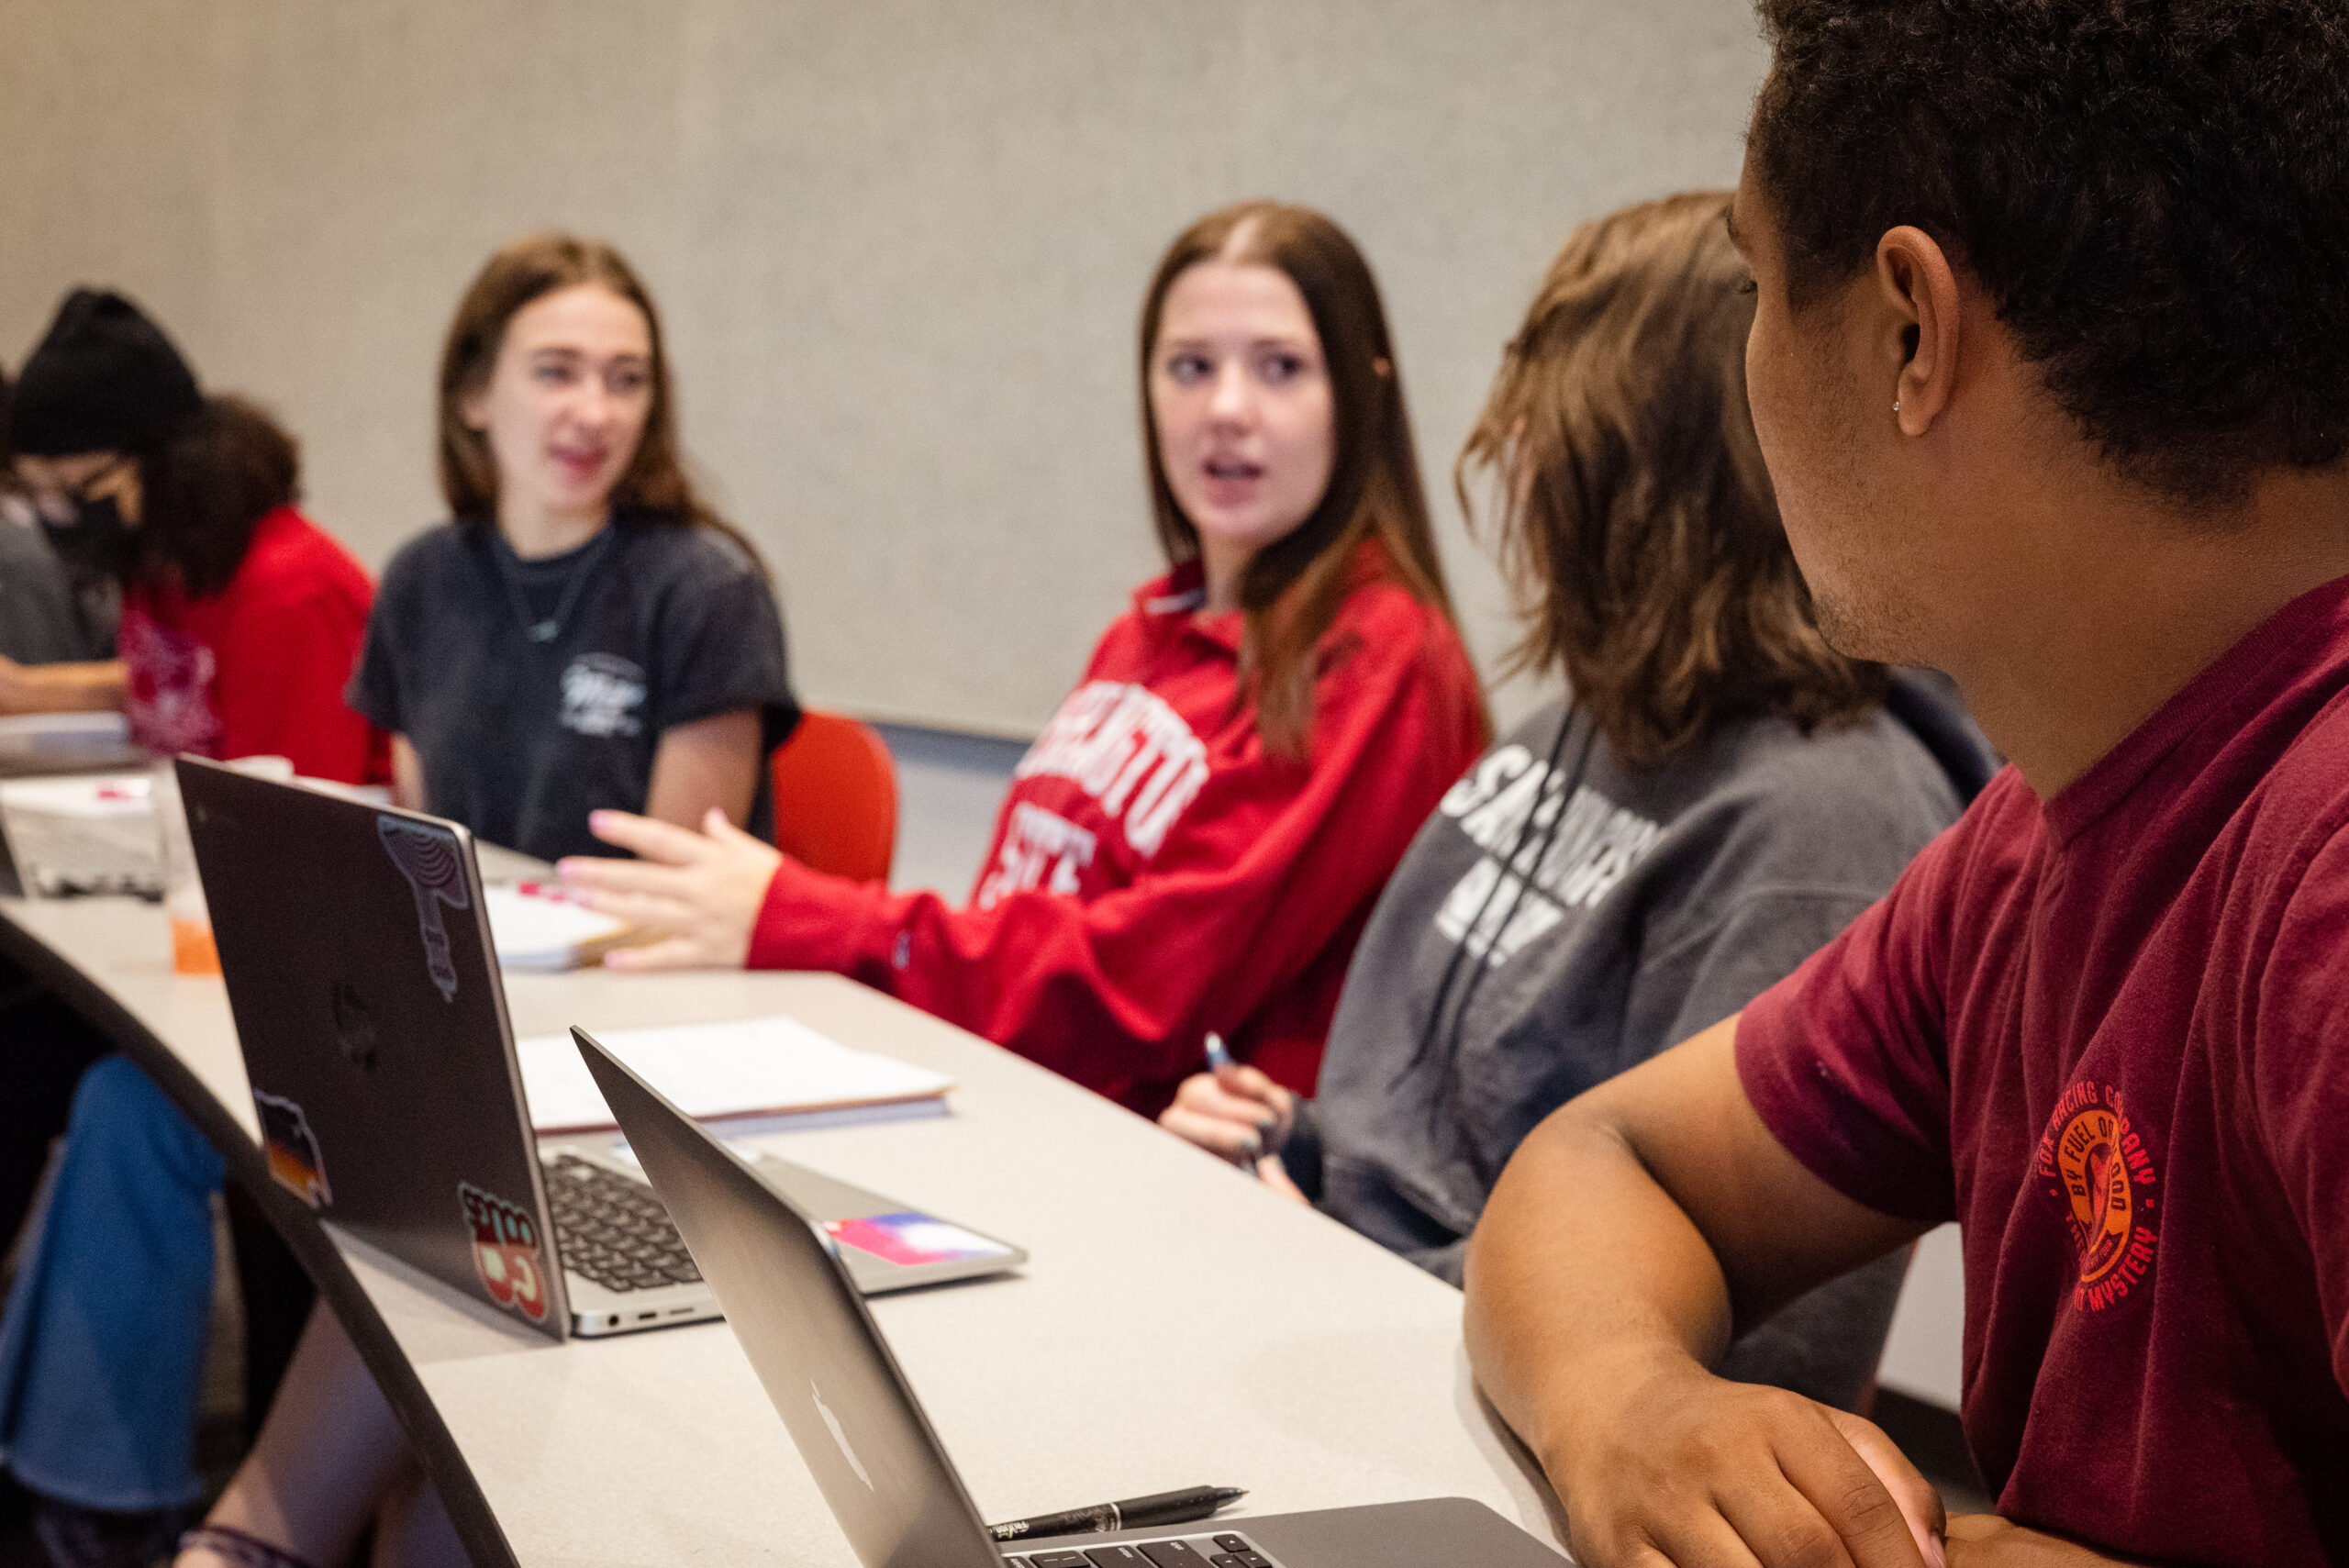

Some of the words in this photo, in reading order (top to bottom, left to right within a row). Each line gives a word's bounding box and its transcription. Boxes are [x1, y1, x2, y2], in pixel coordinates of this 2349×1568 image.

[2038, 1134, 2057, 1178] FOX
[2052, 1081, 2099, 1131] RACING
[2105, 1084, 2156, 1184] COPANY
[2064, 1120, 2096, 1163] FUEL
[2067, 1171, 2087, 1197] BY
[2087, 1226, 2156, 1312] MYSTERY
